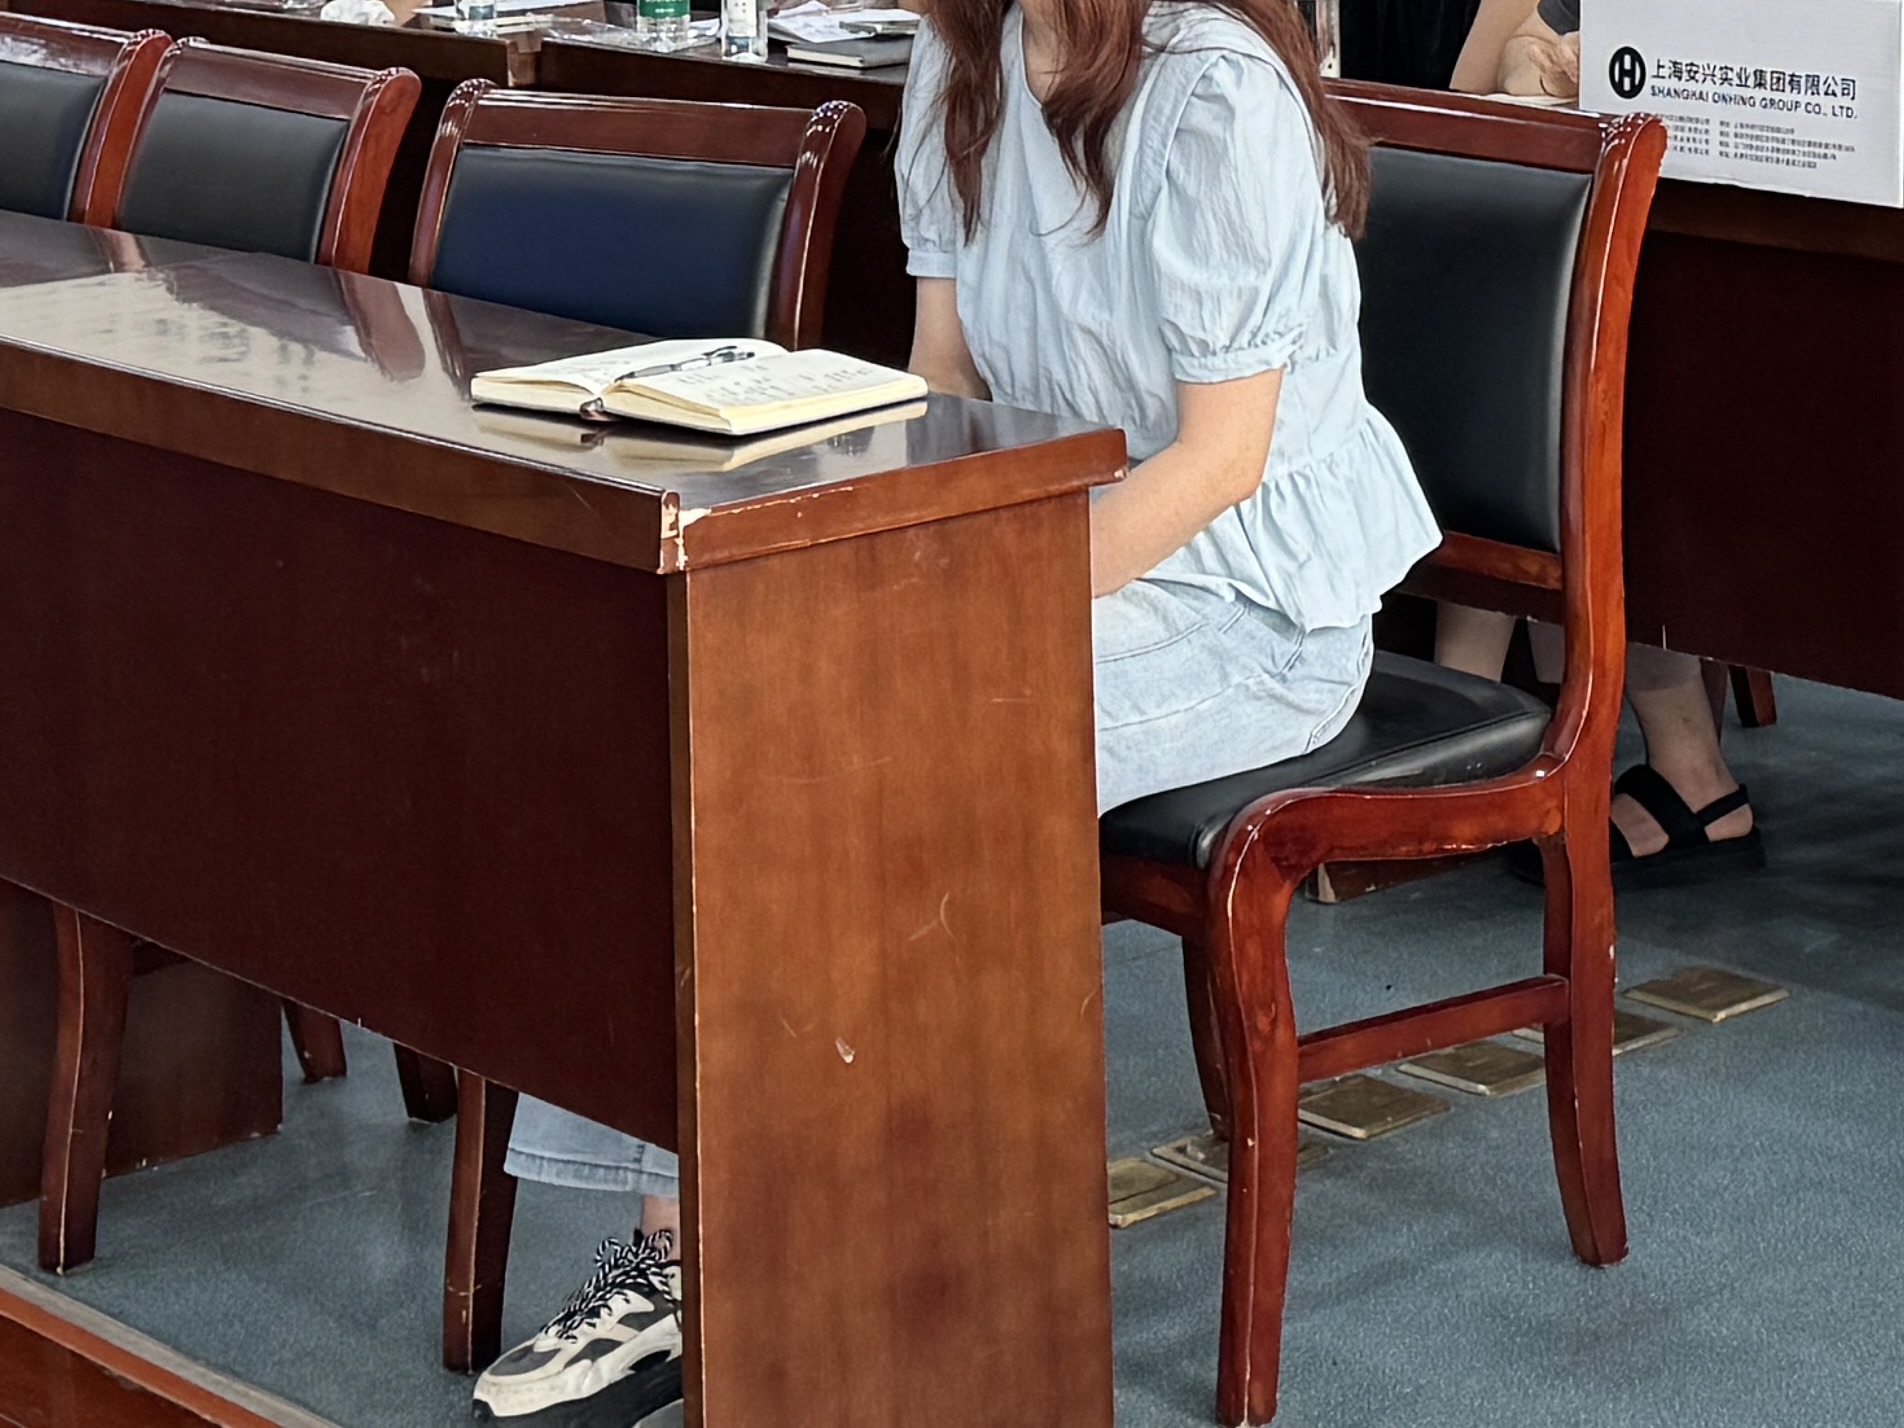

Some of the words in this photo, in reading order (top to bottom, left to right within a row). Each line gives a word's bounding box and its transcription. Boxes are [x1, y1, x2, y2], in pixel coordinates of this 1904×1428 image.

[1651, 58, 1858, 102] 上海安兴实业集团有限公司
[1650, 85, 1710, 104] SHANGHAI
[1759, 96, 1802, 113] GROUP
